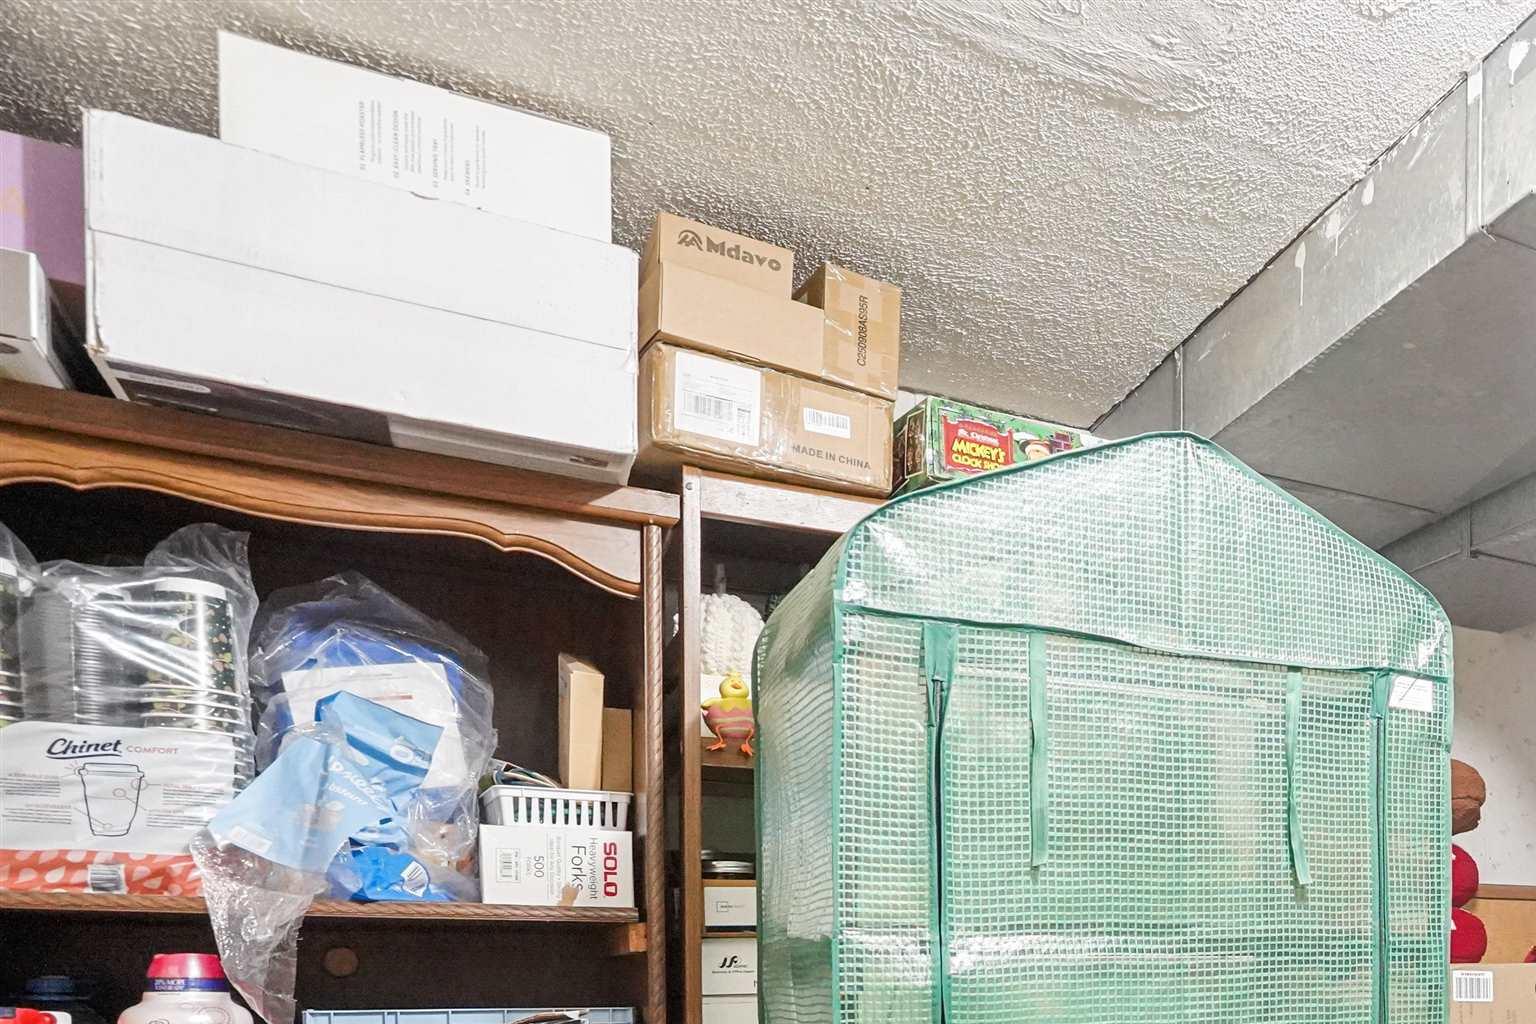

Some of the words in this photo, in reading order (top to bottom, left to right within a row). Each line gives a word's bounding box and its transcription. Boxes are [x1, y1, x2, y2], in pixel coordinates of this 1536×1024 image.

[706, 236, 782, 272] Mdavo
[792, 444, 824, 459] MADE
[825, 451, 837, 461] IN
[838, 455, 872, 470] CHINA
[952, 438, 1006, 464] MICKEY'S
[46, 738, 123, 757] Chinet
[126, 745, 178, 755] COMFORT
[533, 855, 545, 878] 500
[571, 845, 587, 891] Forks
[588, 837, 599, 900] Heavyweight
[603, 841, 618, 898] SOLO
